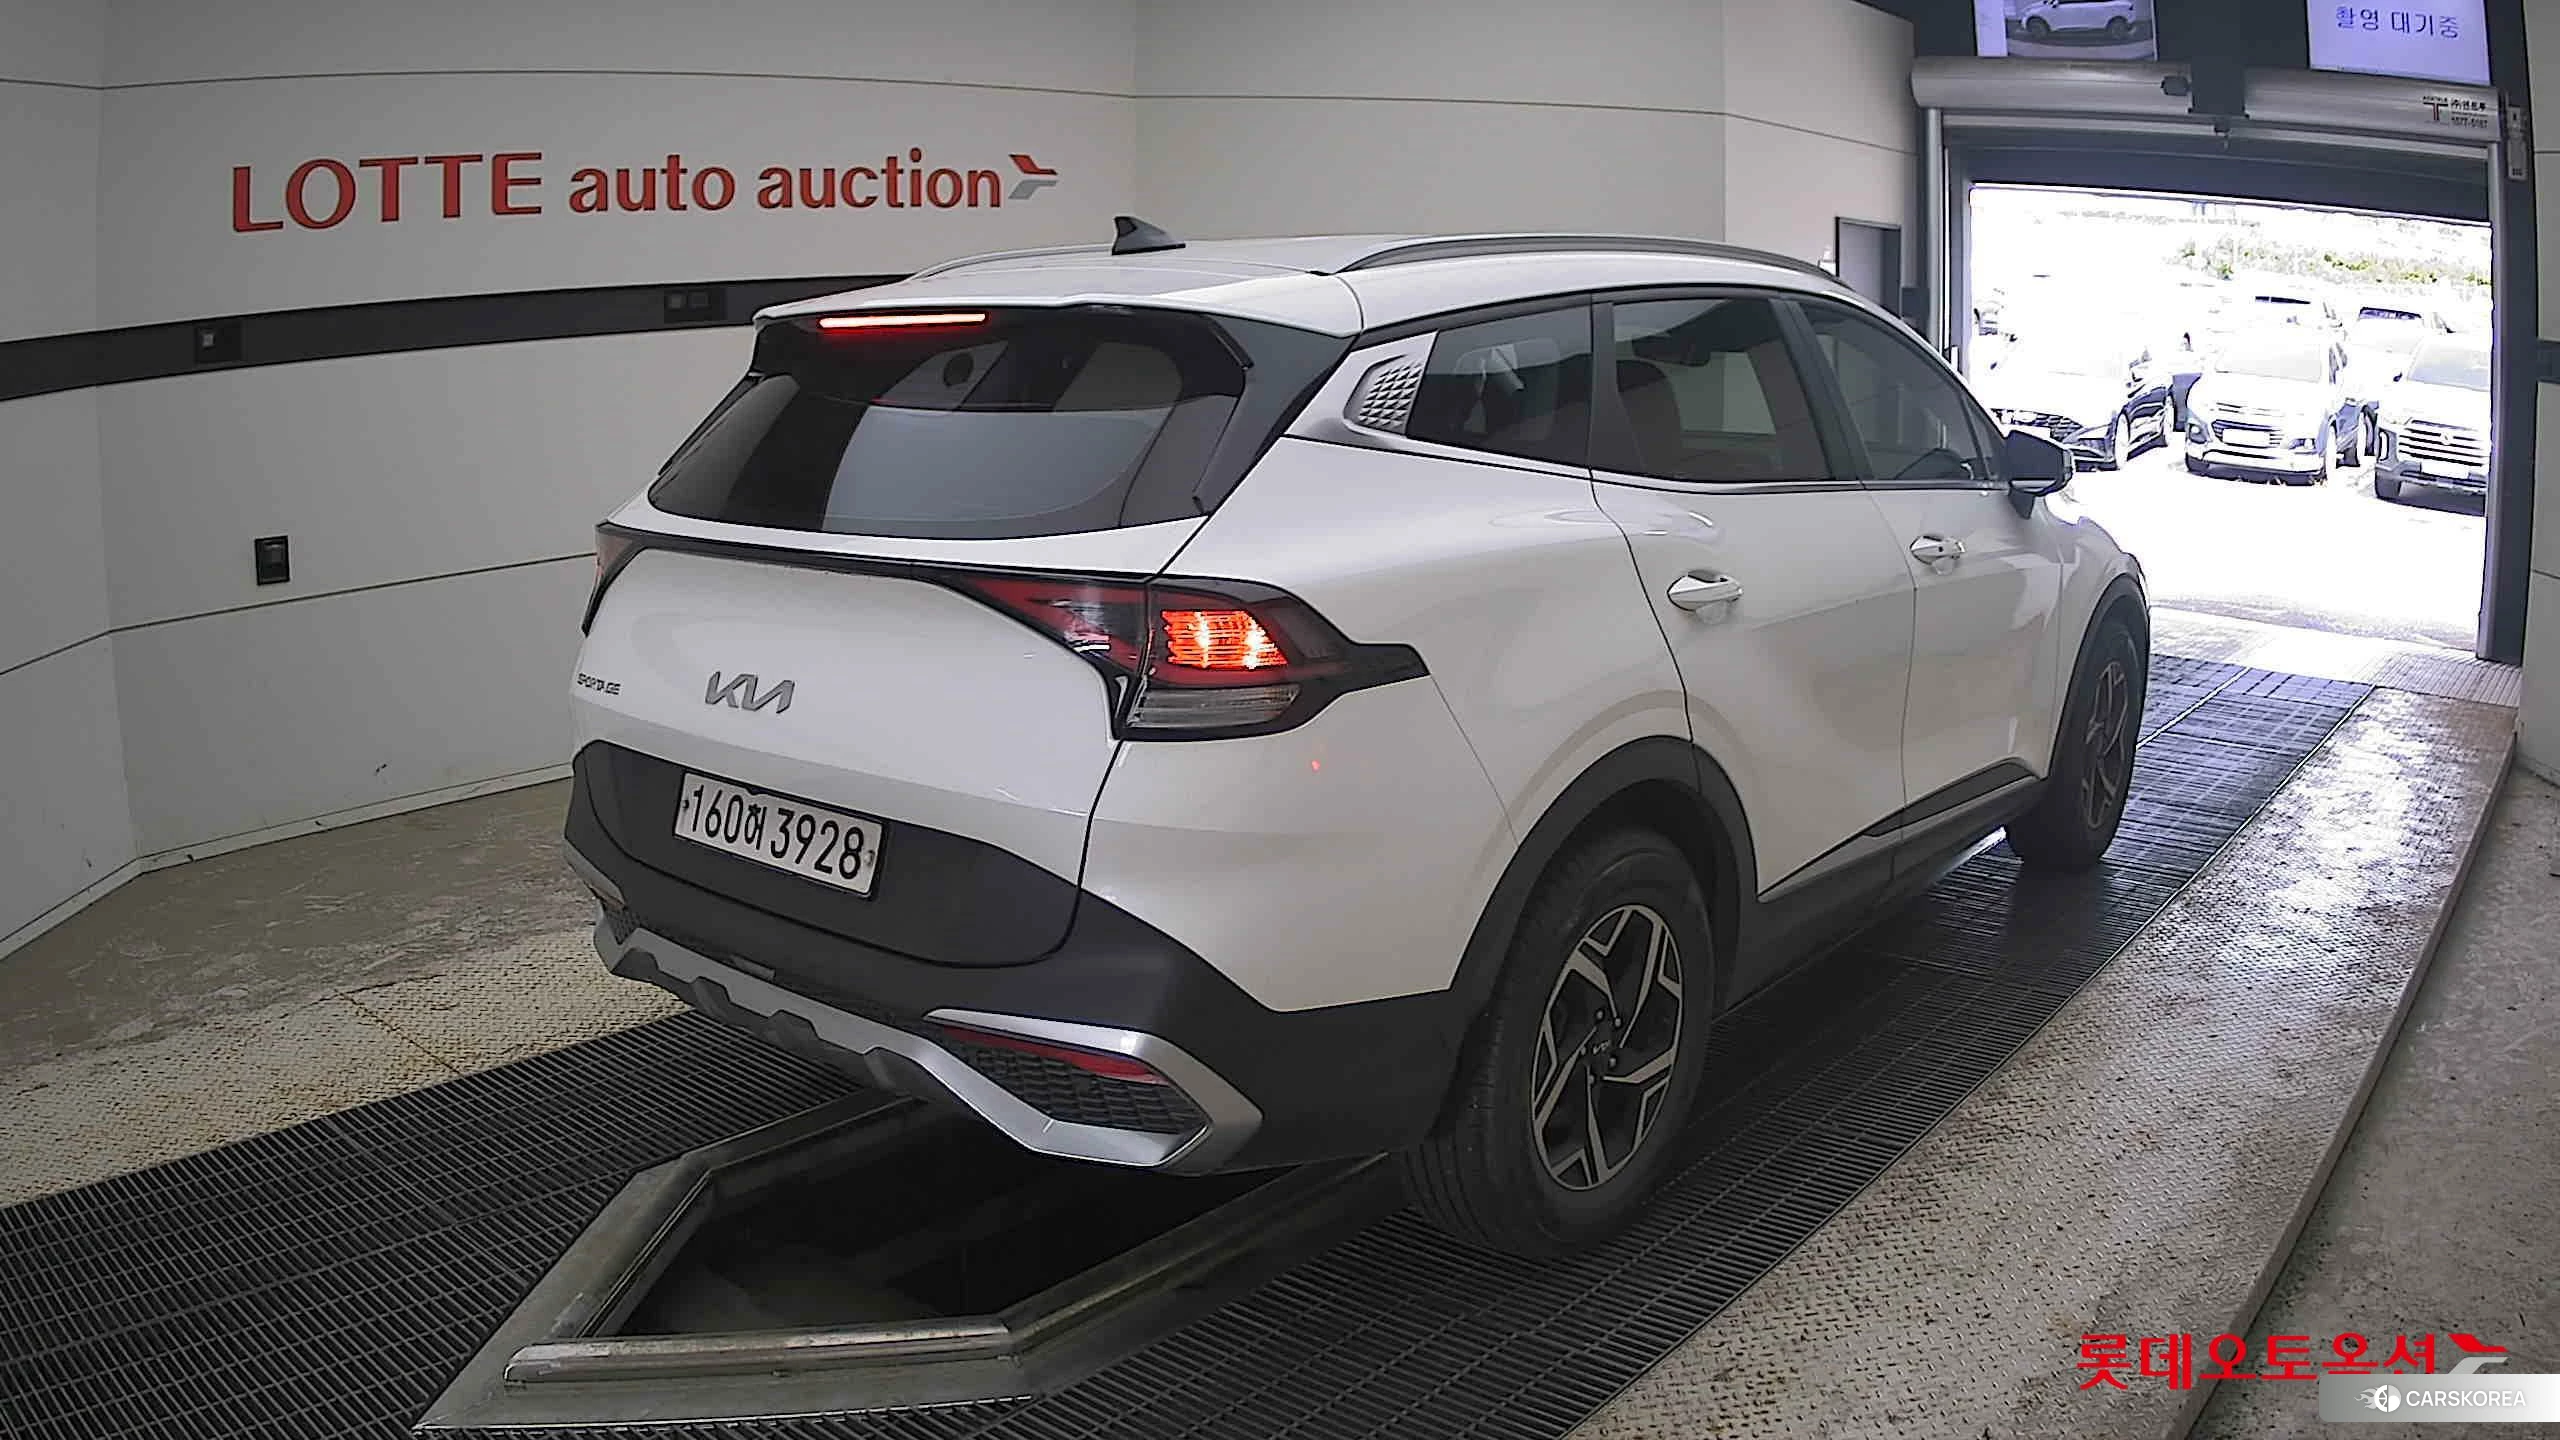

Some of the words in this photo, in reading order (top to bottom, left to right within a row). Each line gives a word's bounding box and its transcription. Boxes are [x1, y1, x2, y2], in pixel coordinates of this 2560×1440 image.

[2391, 11, 2459, 39] 대기중
[232, 151, 543, 232] LOTTE
[568, 154, 736, 213] auto
[757, 147, 1002, 209] auction
[705, 670, 795, 714] KIA
[770, 807, 864, 880] 3928
